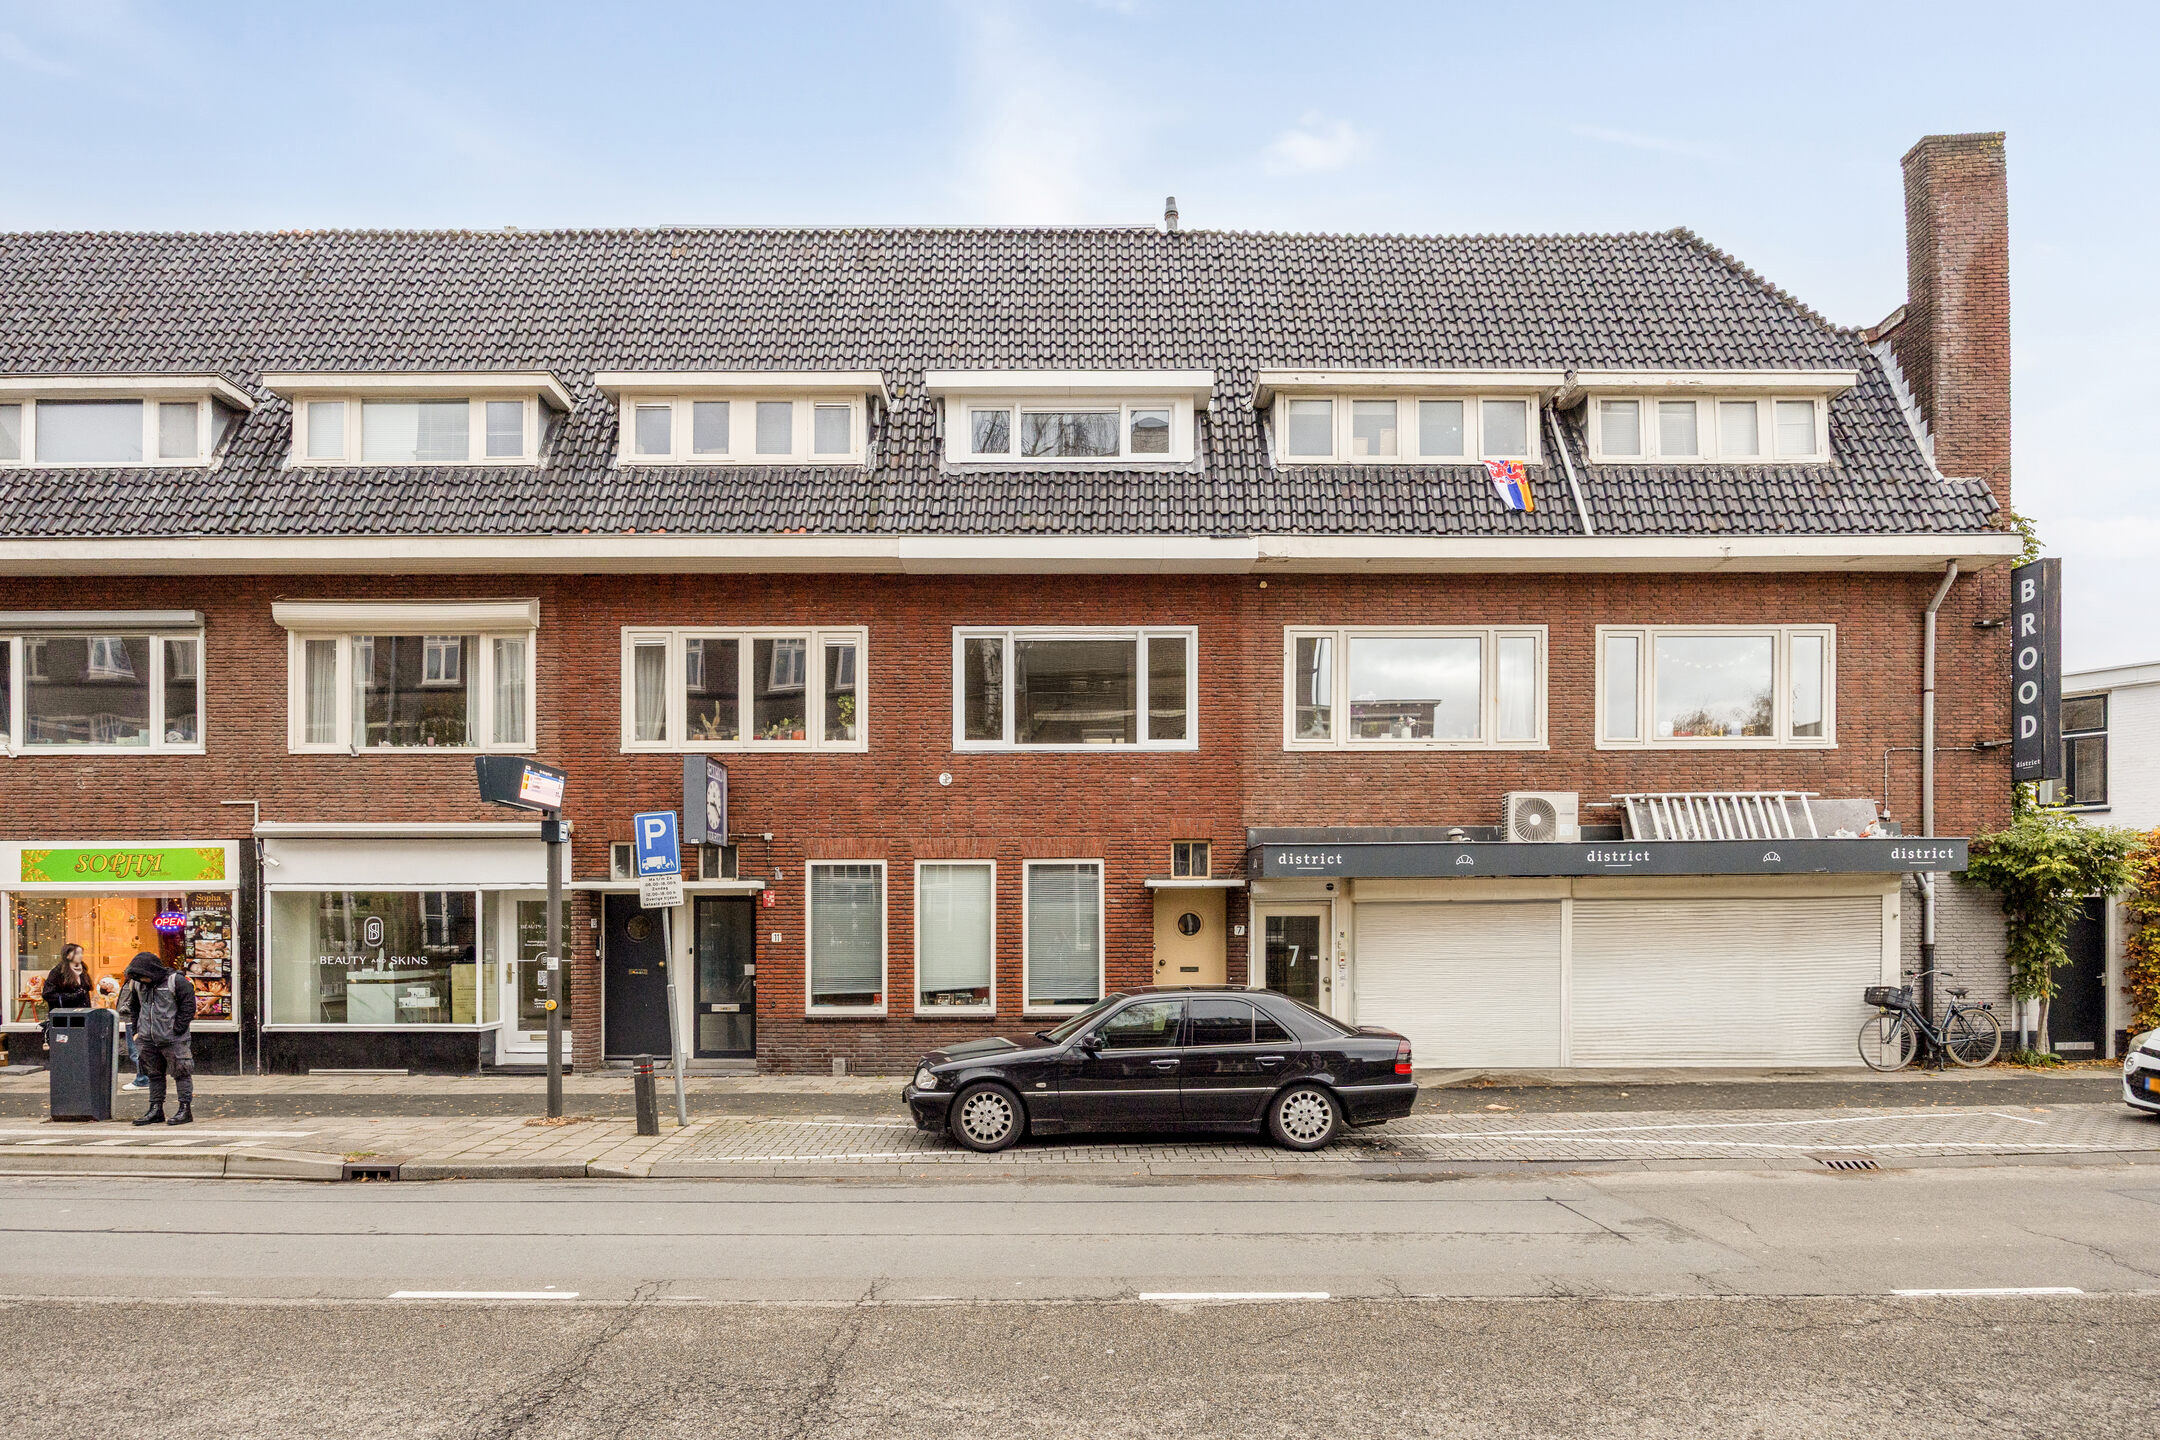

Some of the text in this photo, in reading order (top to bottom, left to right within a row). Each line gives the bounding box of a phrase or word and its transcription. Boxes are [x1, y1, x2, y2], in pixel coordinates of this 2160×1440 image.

[2018, 578, 2038, 739] BROOD
[2016, 759, 2041, 768] district
[644, 818, 667, 850] P
[1278, 852, 1342, 865] district
[1587, 850, 1650, 862] district
[1891, 847, 1954, 859] district
[74, 852, 164, 878] SOPHA
[196, 894, 221, 902] Sopha
[155, 917, 185, 926] OPEN
[1236, 926, 1242, 934] 7
[773, 933, 780, 941] 11
[320, 956, 367, 965] BEAUTY
[390, 956, 428, 965] SKINS
[1288, 945, 1300, 967] 7
